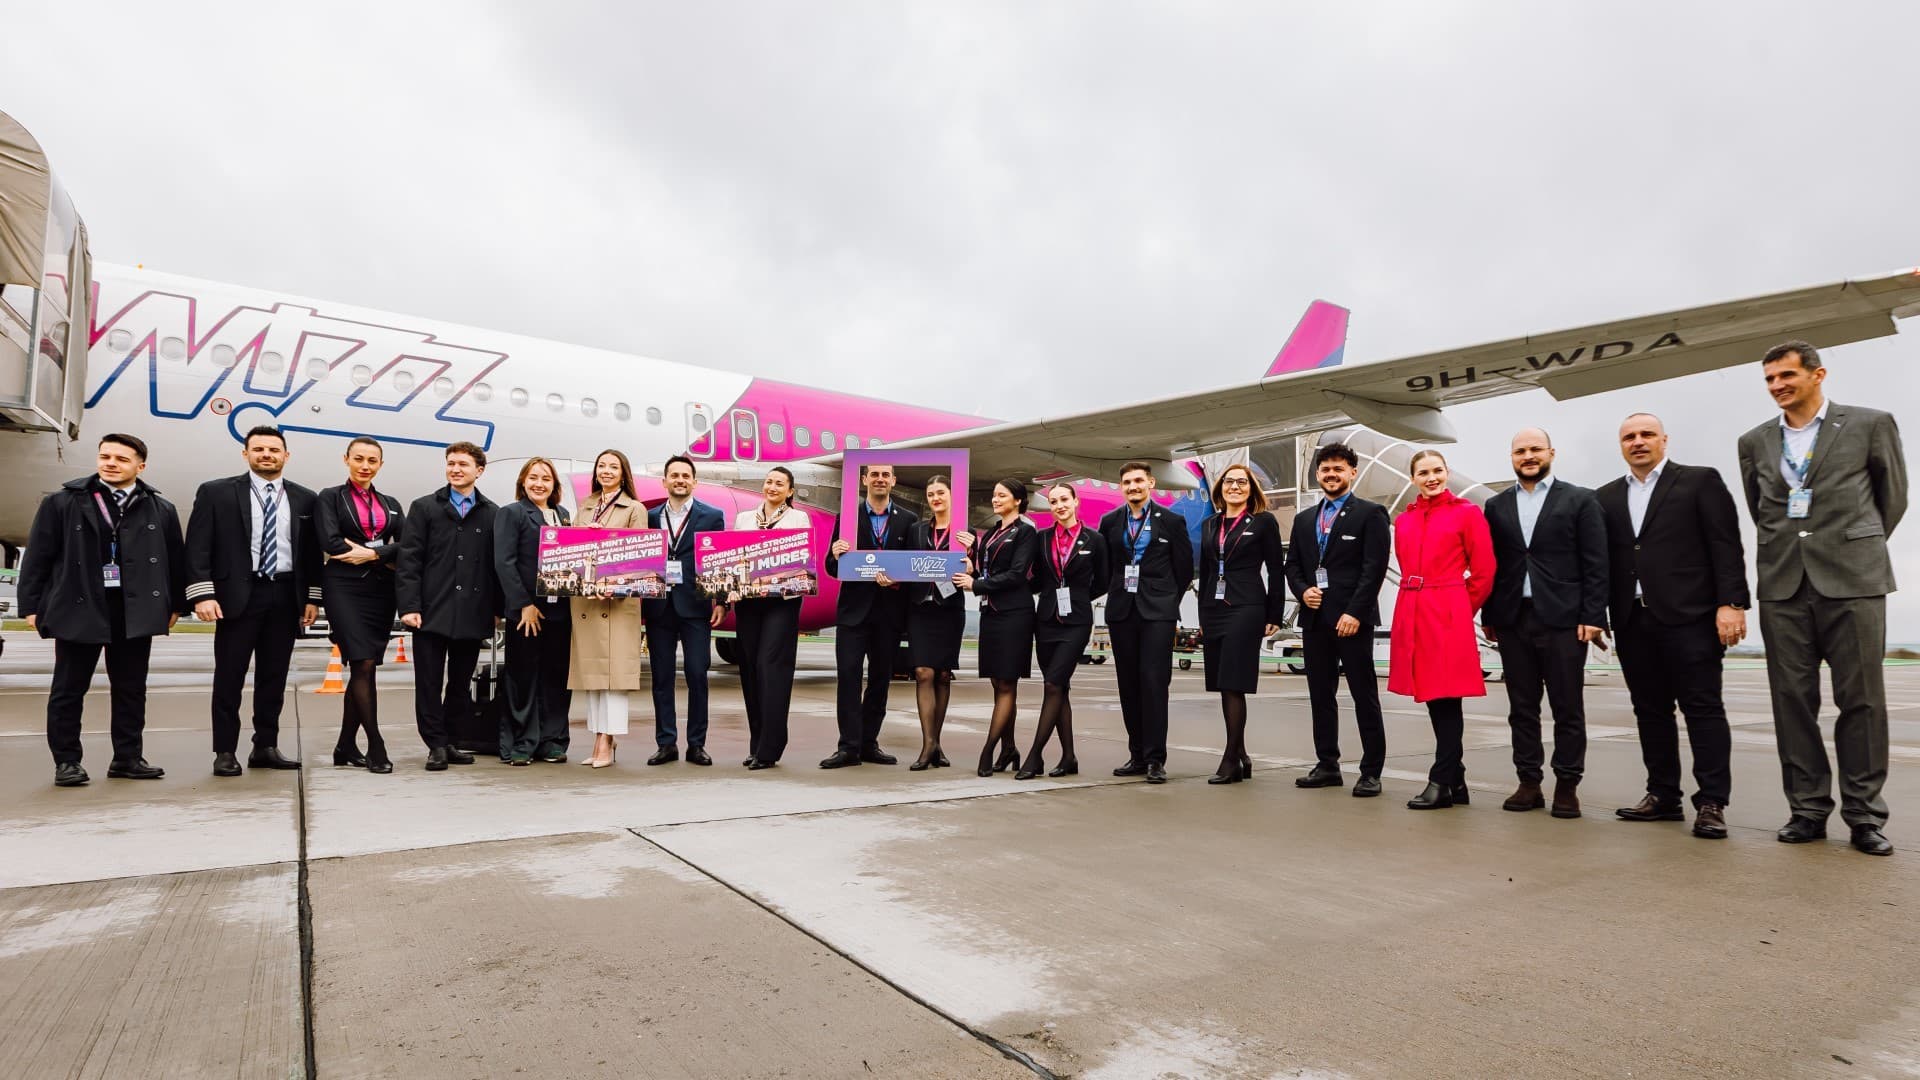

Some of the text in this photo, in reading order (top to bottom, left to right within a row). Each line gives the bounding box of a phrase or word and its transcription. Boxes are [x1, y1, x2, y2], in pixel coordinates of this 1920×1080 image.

[1405, 332, 1686, 392] 9H-WDA
[601, 538, 624, 548] MINT
[625, 532, 662, 545] VALAHA
[702, 548, 737, 562] COMING
[762, 532, 808, 548] STRONGER
[712, 558, 726, 567] OUR
[726, 554, 744, 563] FIRST
[772, 545, 780, 553] IN
[780, 538, 809, 550] ROMANIA
[541, 546, 663, 572] MAROSVSÁRHELYRE
[757, 548, 810, 571] MUREȘ
